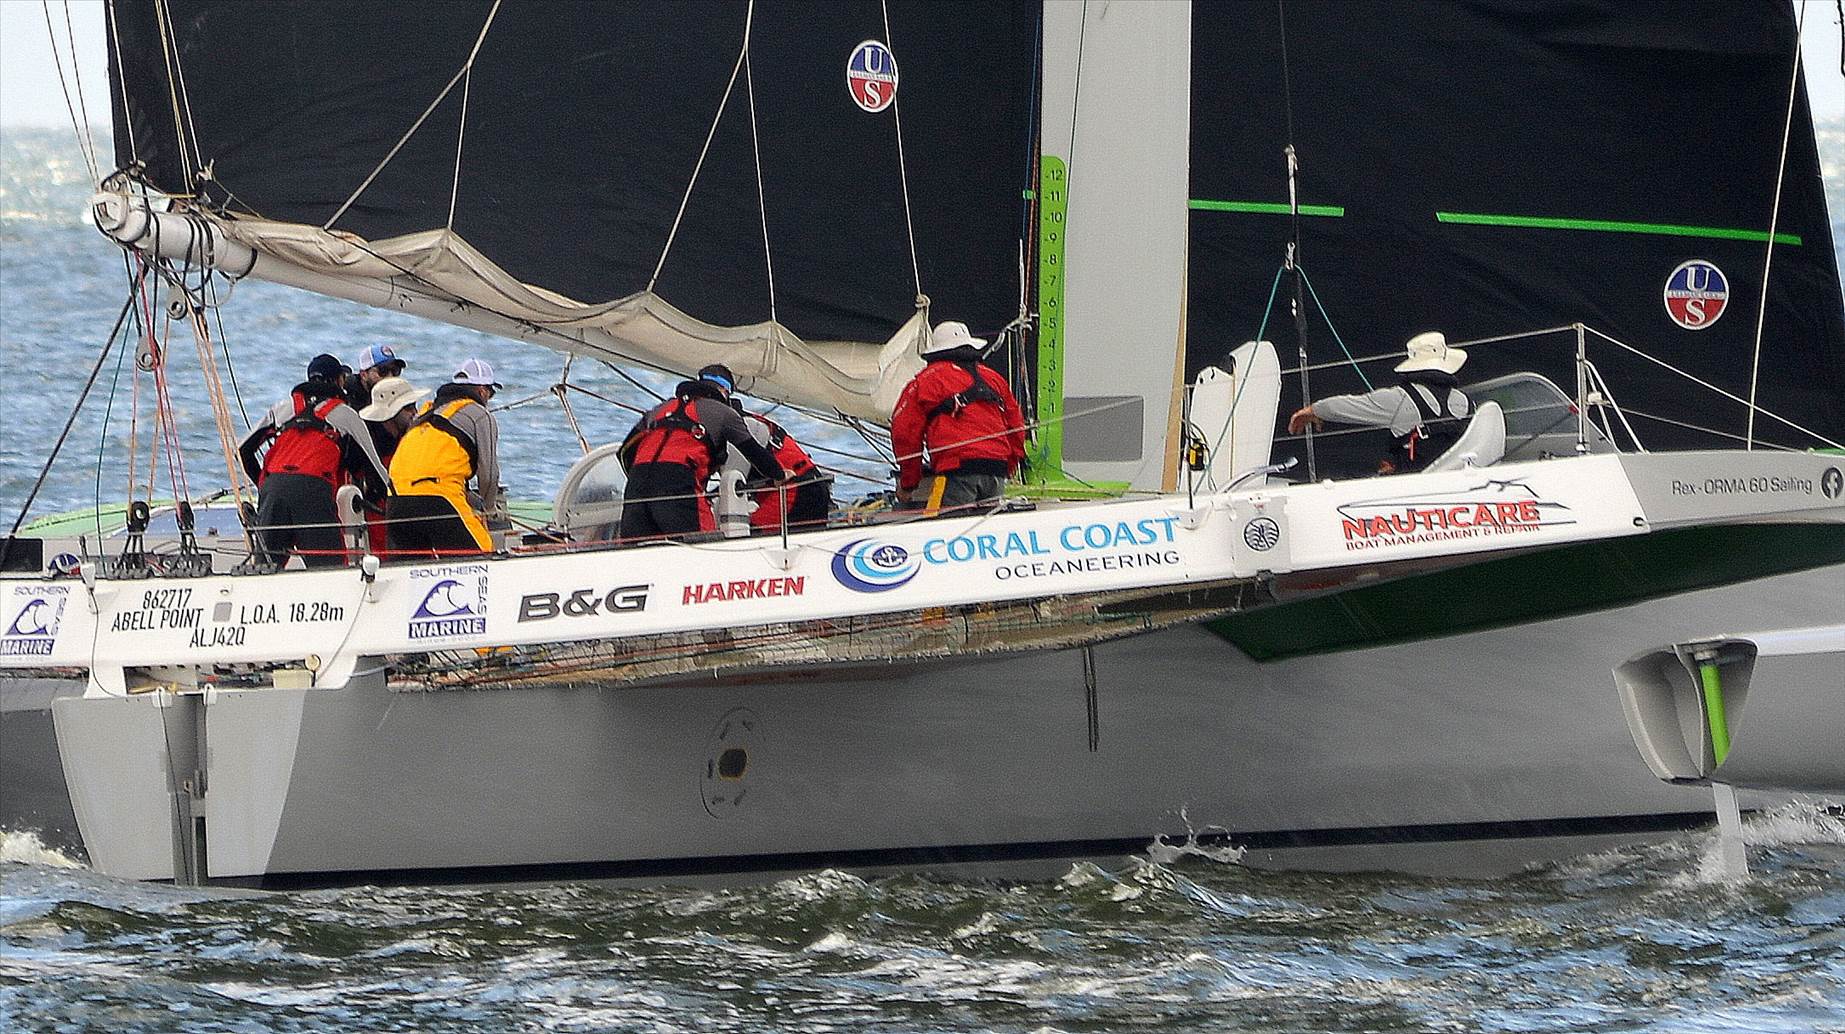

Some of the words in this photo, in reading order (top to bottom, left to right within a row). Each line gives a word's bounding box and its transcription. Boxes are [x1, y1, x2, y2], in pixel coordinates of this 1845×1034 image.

[863, 46, 884, 73] U
[863, 80, 881, 109] S
[1686, 267, 1712, 291] U
[1685, 299, 1706, 325] S
[1672, 480, 1696, 495] Rex
[1704, 478, 1747, 494] ORMA
[1749, 477, 1768, 493] 60
[1770, 477, 1812, 495] Sailing
[1342, 501, 1540, 540] NAUTICARE
[923, 530, 1050, 565] CORAL
[1060, 516, 1180, 552] COAST
[1346, 538, 1382, 551] BOAT
[1384, 528, 1480, 546] MANAGEMENT
[410, 564, 489, 579] SOUTHERN
[995, 551, 1180, 580] OCEANEERING
[142, 588, 192, 610] 862717
[682, 576, 805, 605] HARKEN
[240, 604, 280, 625] L.O.A.
[289, 602, 344, 623] 18.28m
[517, 584, 649, 623] B&G
[111, 610, 155, 632] ABELL
[160, 608, 204, 629] POINT
[410, 619, 485, 638] MARINE
[0, 640, 52, 655] MARINE
[189, 626, 246, 648] ALJ42Q
